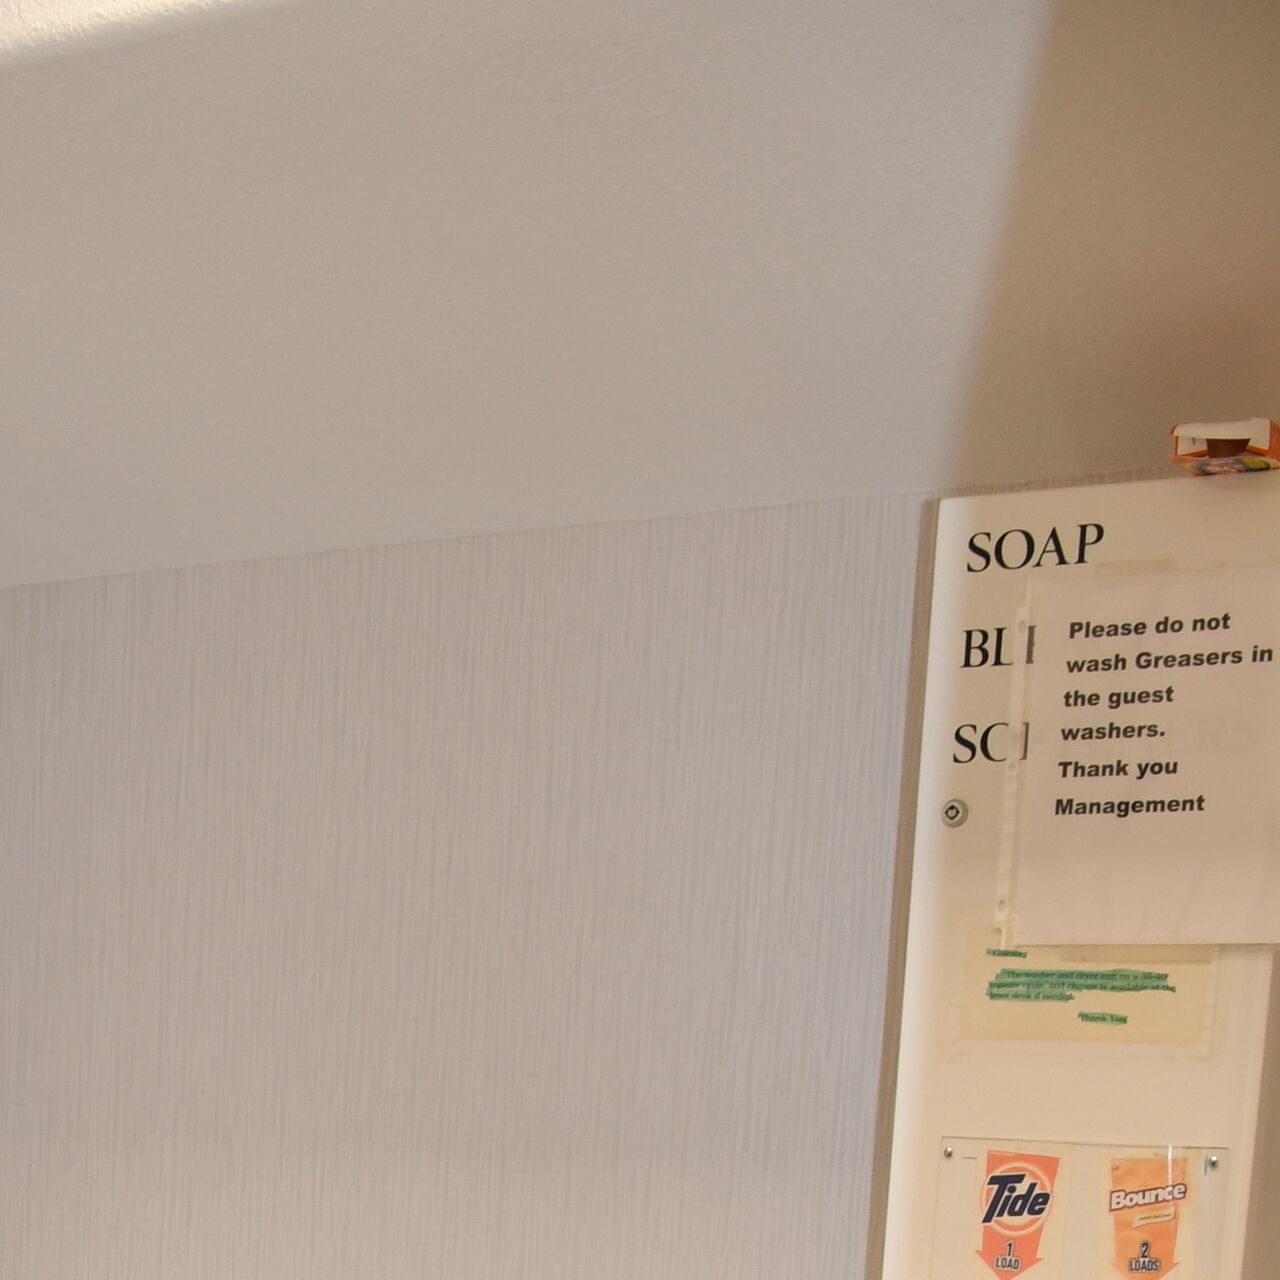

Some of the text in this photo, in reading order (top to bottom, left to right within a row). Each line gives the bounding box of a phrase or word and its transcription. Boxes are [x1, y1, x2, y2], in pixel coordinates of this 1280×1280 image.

[967, 523, 1104, 572] SOAP
[1069, 613, 1231, 639] Please do not
[1066, 646, 1273, 673] wash Greasers in
[1064, 686, 1174, 709] the guest
[1061, 723, 1165, 740] washers.
[1058, 760, 1178, 779] Thank you
[1054, 795, 1205, 817] Management
[982, 1174, 1050, 1223] Tide
[1110, 1184, 1186, 1211] Bounce
[1006, 1242, 1012, 1256] 1
[1141, 1242, 1149, 1258] 2
[996, 1257, 1020, 1270] LOAD
[1130, 1260, 1159, 1271] LOADS
